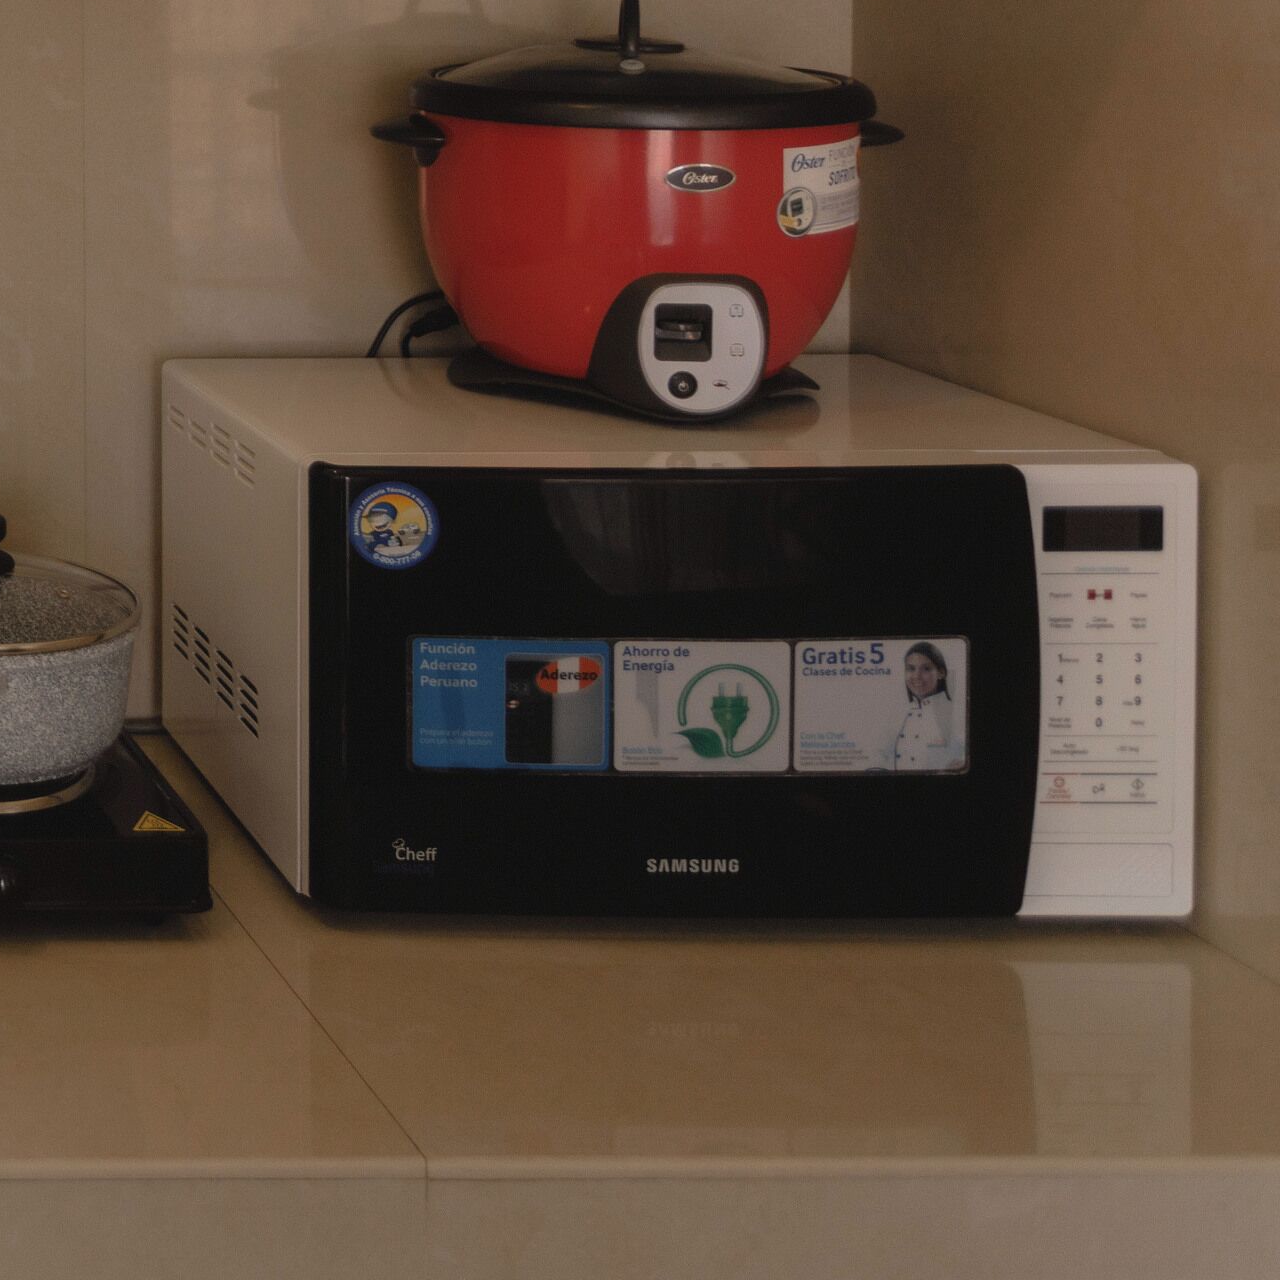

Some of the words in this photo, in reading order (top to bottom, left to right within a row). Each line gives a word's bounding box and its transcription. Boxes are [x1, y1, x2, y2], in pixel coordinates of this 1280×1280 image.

[791, 153, 825, 173] Oster
[682, 171, 718, 185] Oster
[420, 642, 476, 655] Función
[622, 646, 670, 657] Ahorro
[673, 646, 690, 657] de
[802, 647, 866, 665] Gratis
[869, 643, 885, 665] 5
[1095, 652, 1104, 663] 2
[1134, 652, 1143, 663] 3
[420, 659, 477, 671] Aderezo
[622, 660, 675, 674] Energía
[540, 669, 599, 681] Aderezo
[802, 667, 837, 677] Clases
[839, 667, 852, 677] de
[855, 666, 891, 676] Cocina
[420, 676, 478, 688] Peruano
[395, 847, 437, 861] Cheff
[646, 858, 740, 873] SAMSUNG
